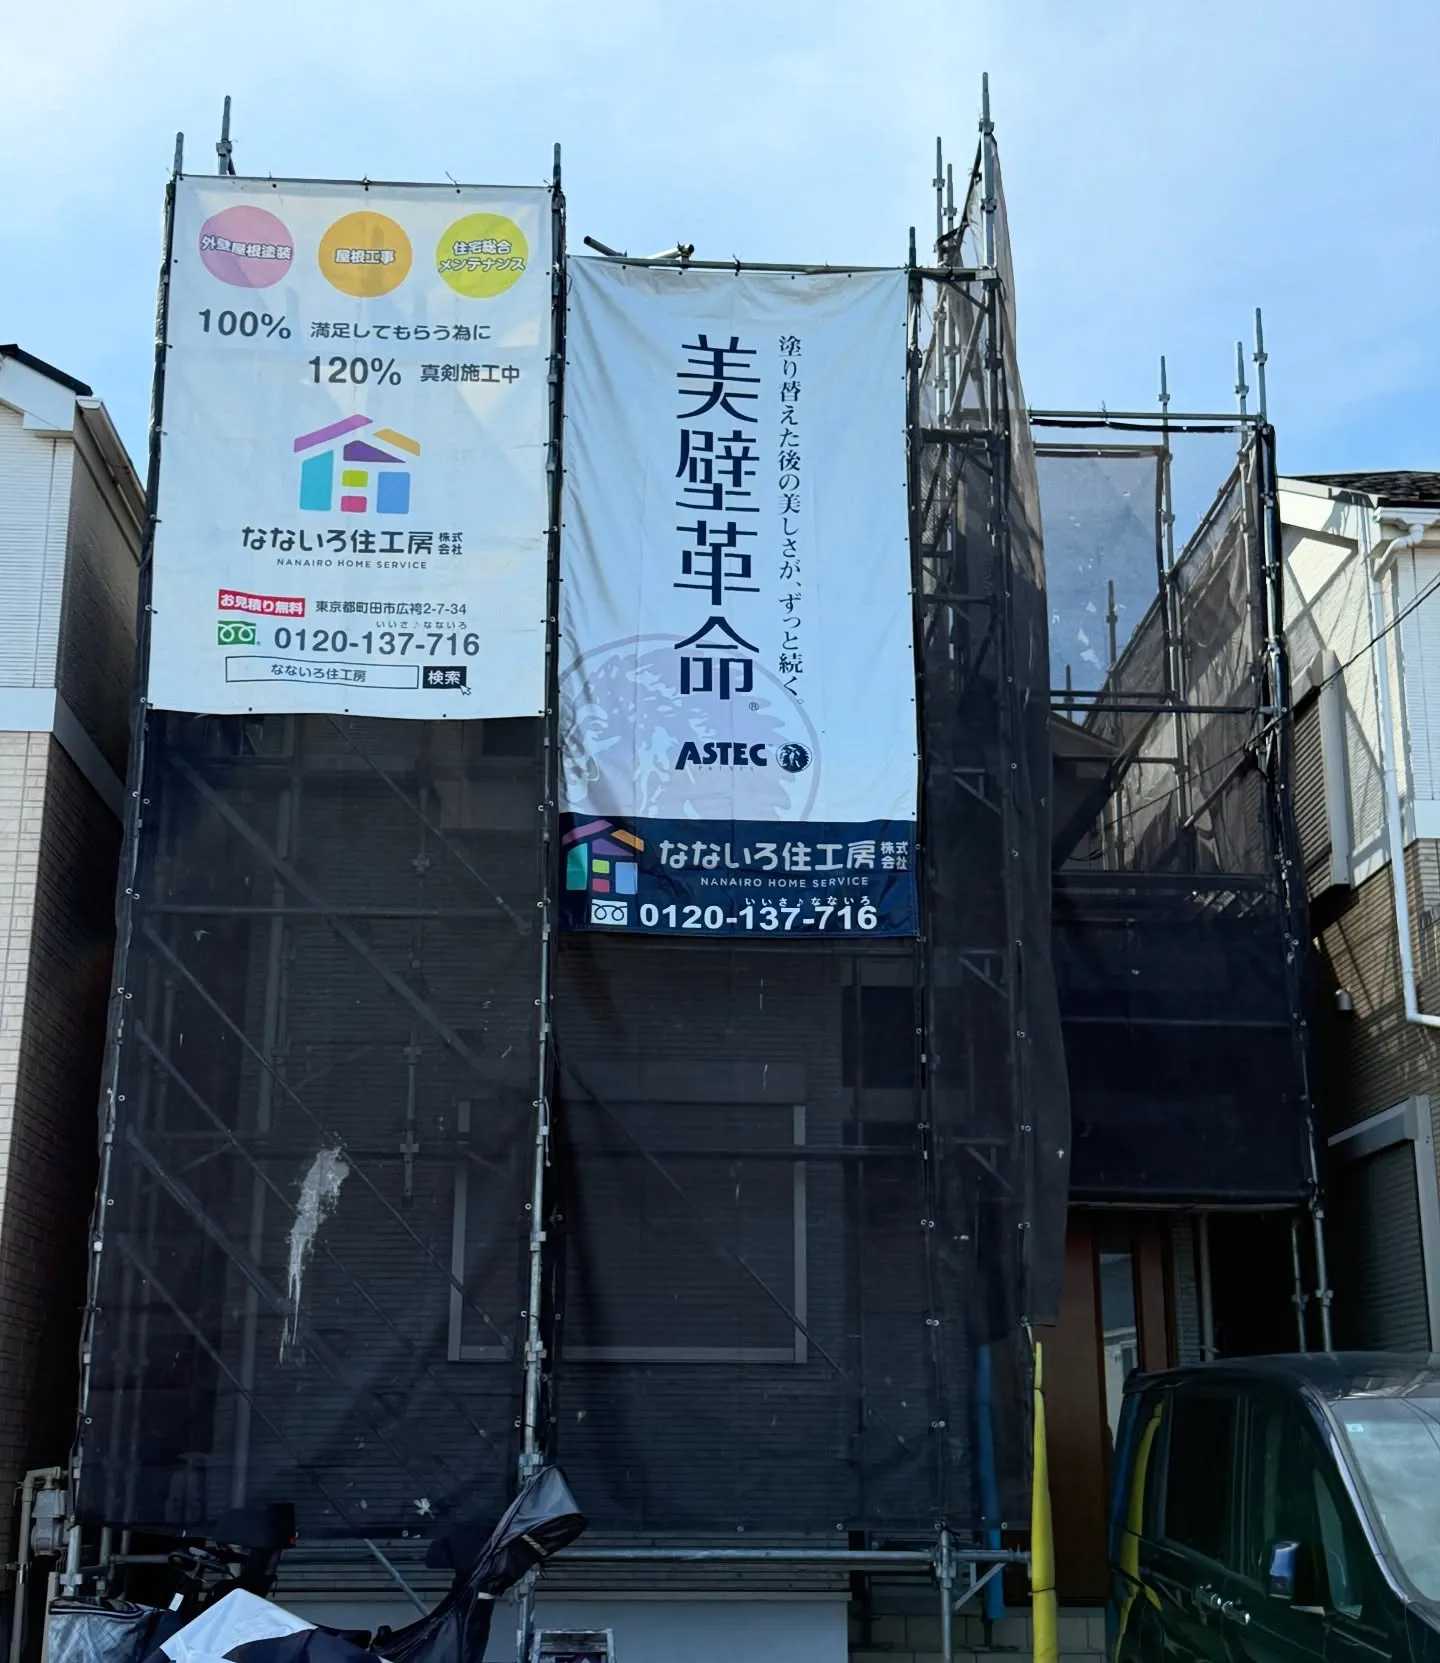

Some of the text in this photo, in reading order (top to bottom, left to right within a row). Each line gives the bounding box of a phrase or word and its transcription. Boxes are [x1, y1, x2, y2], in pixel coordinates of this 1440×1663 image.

[335, 248, 396, 264] 屋根工事
[453, 239, 512, 256] 住宅総合
[438, 256, 526, 273] メンテナンス
[199, 308, 491, 341] 100% 満足してもらう為に
[308, 355, 520, 386] 120% 真剣施工中
[674, 333, 761, 700] 美壁革命
[241, 526, 434, 555] なないろ住工房
[276, 557, 427, 570] NANAIRO HOME SERVICE
[220, 594, 304, 615] お見積り無料
[274, 627, 480, 656] 0120-137-716
[270, 664, 367, 683] なないろ住工房
[427, 670, 461, 685] 検索
[675, 741, 768, 770] ASTEC
[659, 840, 876, 871] なないろ住工房
[700, 876, 869, 888] NANAIRO HOME SERVICE
[640, 903, 878, 930] 0120-137-716
